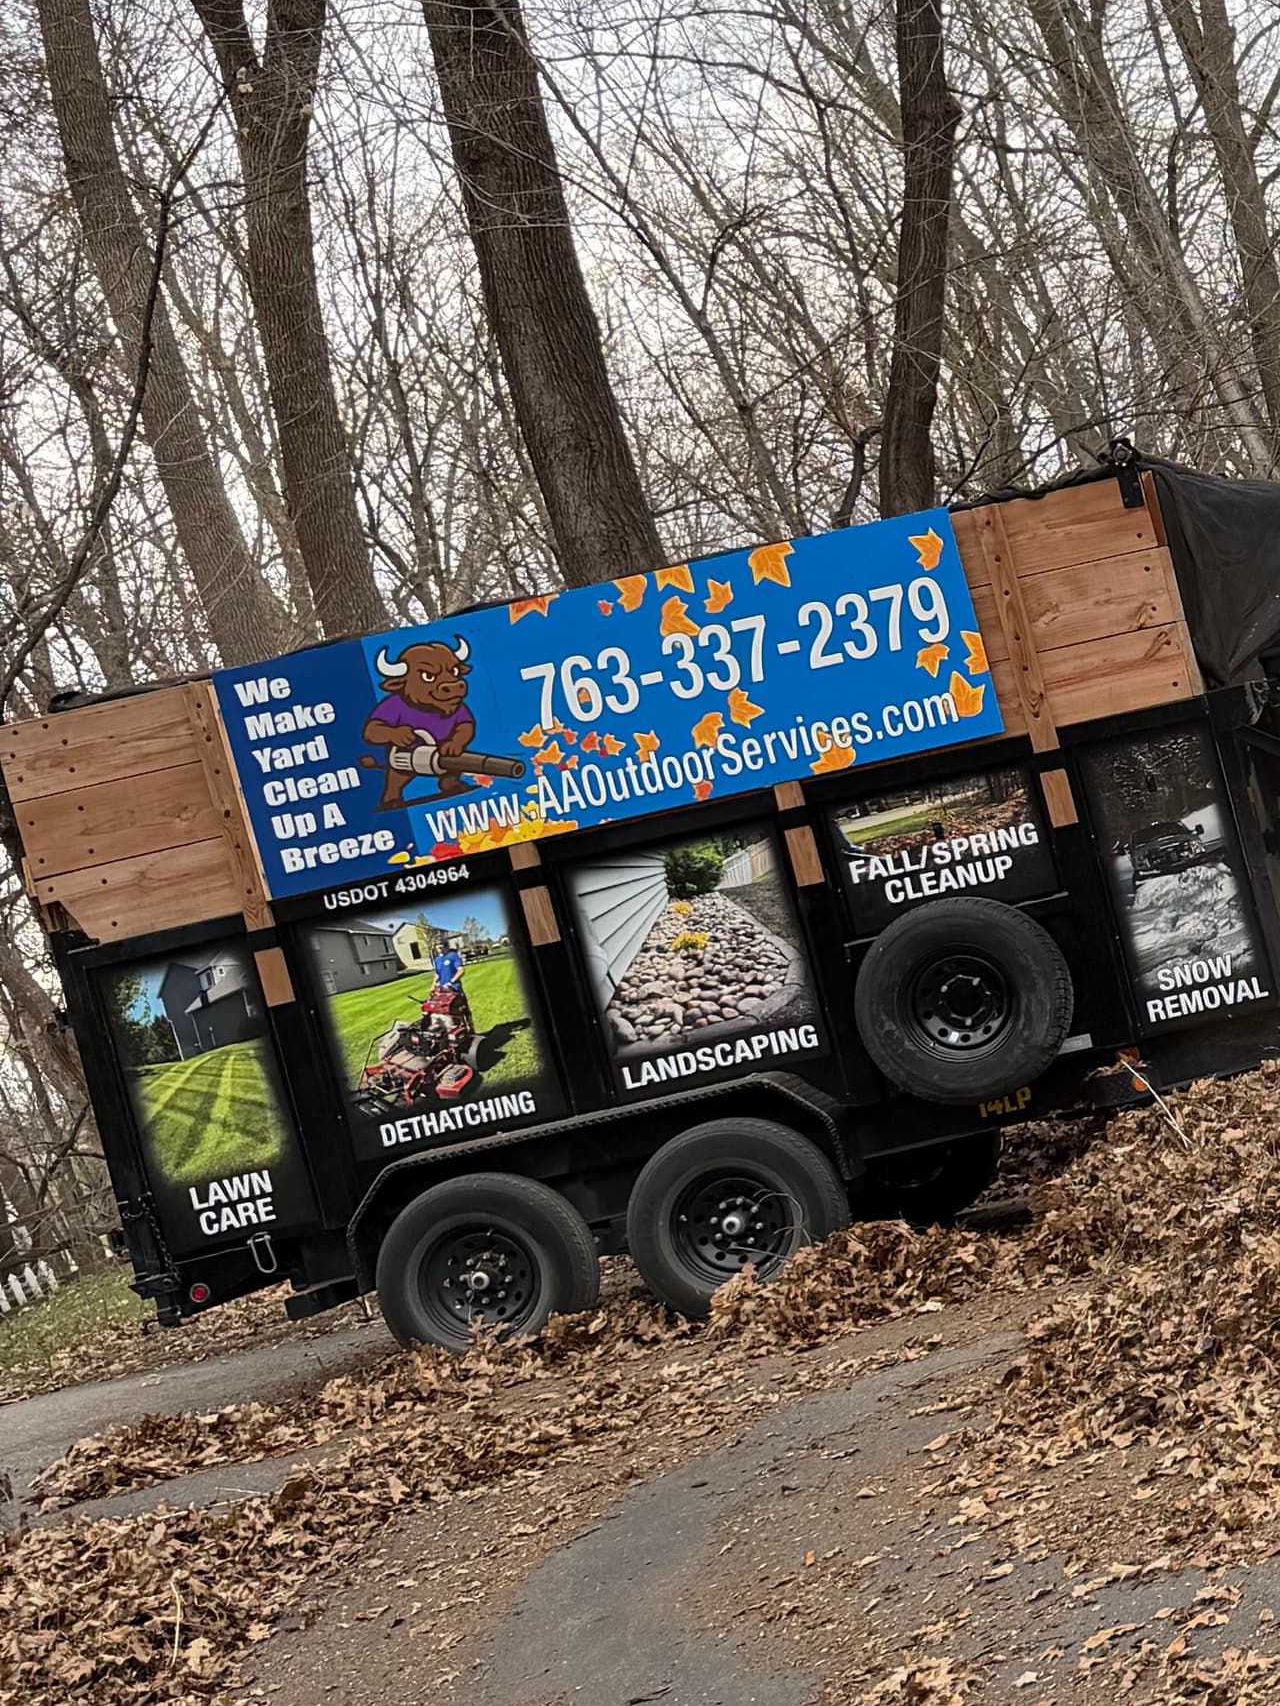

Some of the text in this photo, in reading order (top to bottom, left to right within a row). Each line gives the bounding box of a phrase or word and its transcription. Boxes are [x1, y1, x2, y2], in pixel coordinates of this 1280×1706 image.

[520, 575, 951, 731] 763-337-2379
[233, 673, 292, 707] We
[244, 698, 337, 742] Make
[252, 736, 329, 776] Yard
[425, 690, 960, 844] www.AAOutdoorServices.com
[262, 764, 362, 808] Clean
[272, 801, 347, 841] Up A
[280, 826, 397, 874] Breeze
[849, 822, 1040, 886] FALL/SPRING
[323, 864, 470, 910] USDOT 4304964
[885, 855, 1013, 905] CLEANUP
[1157, 953, 1233, 992] SNOW
[1147, 975, 1269, 1023] REMOVAL
[621, 1024, 819, 1091] LANDSCAPING
[379, 1090, 536, 1148] DETHATCHING
[979, 1086, 1032, 1118] 14LP
[189, 1169, 274, 1212] LAWN
[199, 1195, 277, 1238] CARE
